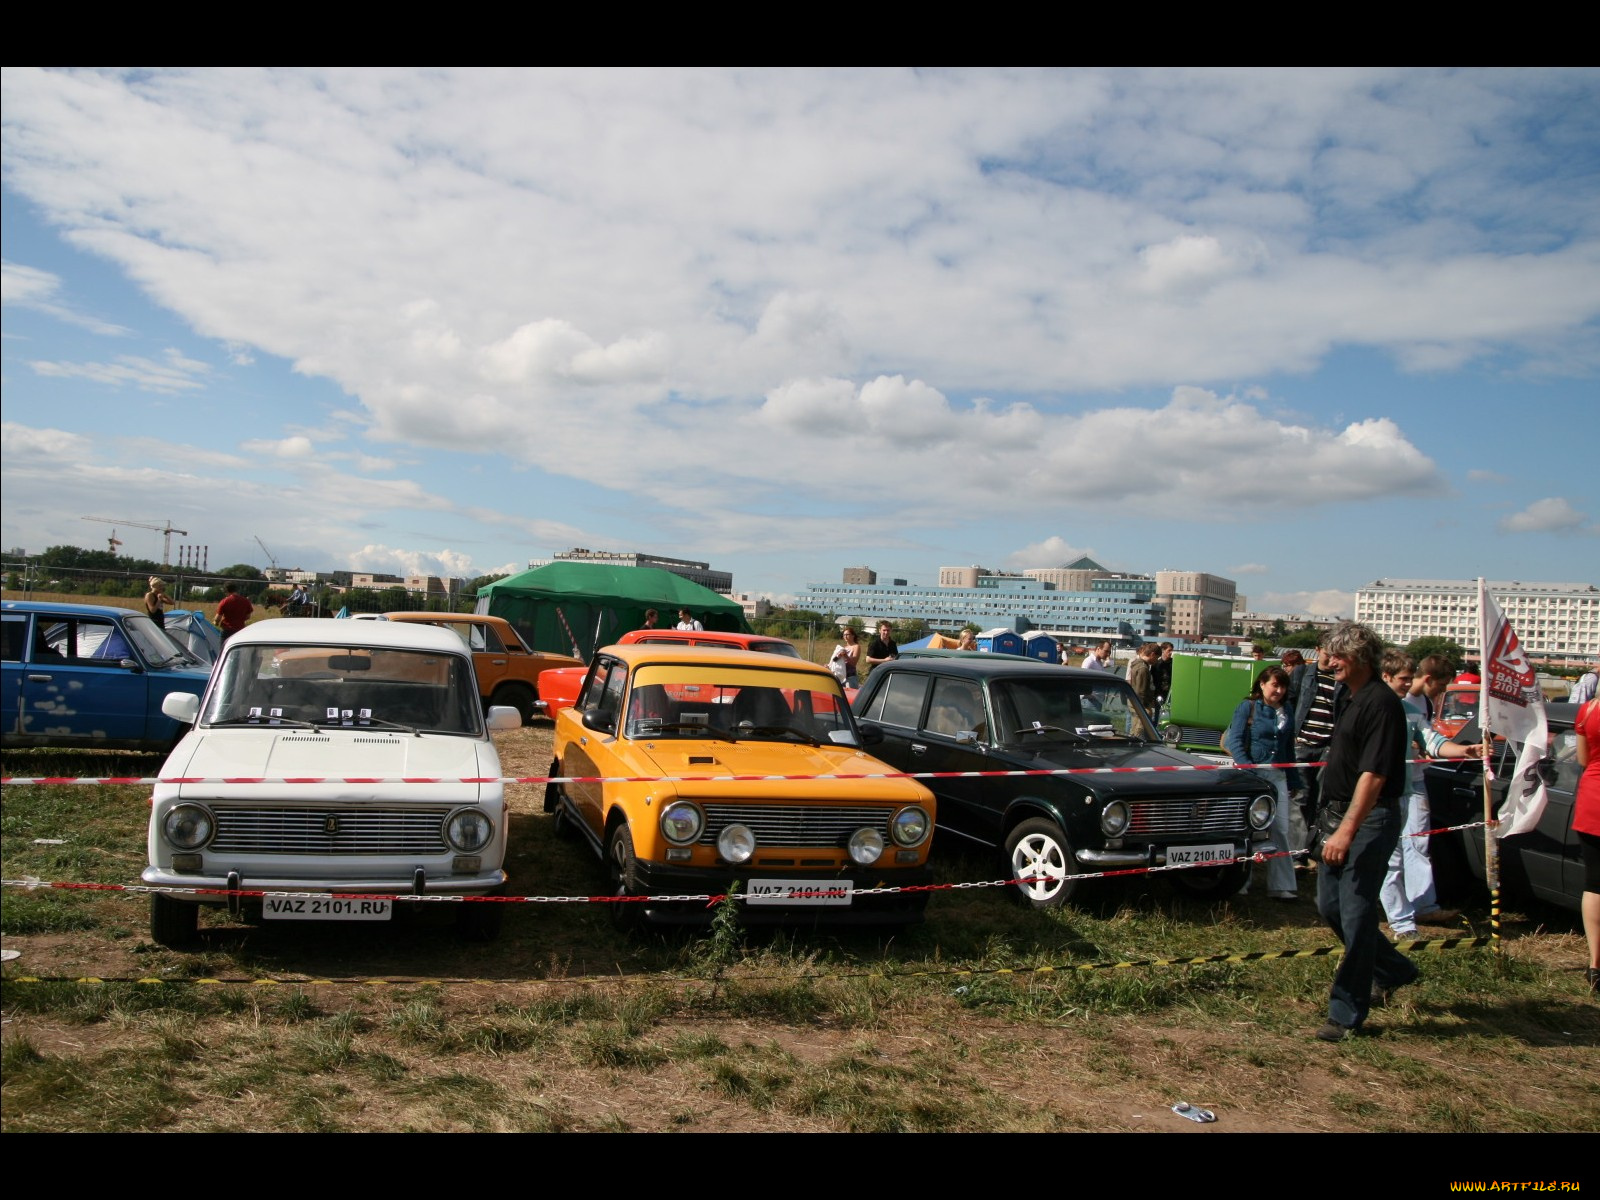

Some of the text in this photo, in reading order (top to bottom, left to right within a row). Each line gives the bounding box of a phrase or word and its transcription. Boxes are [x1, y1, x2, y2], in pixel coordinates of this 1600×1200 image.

[1496, 672, 1520, 687] ВАЗ
[1494, 681, 1518, 696] 2101
[1171, 849, 1231, 862] VAZ 2101.RU
[271, 900, 386, 914] VAZ 2101.RU
